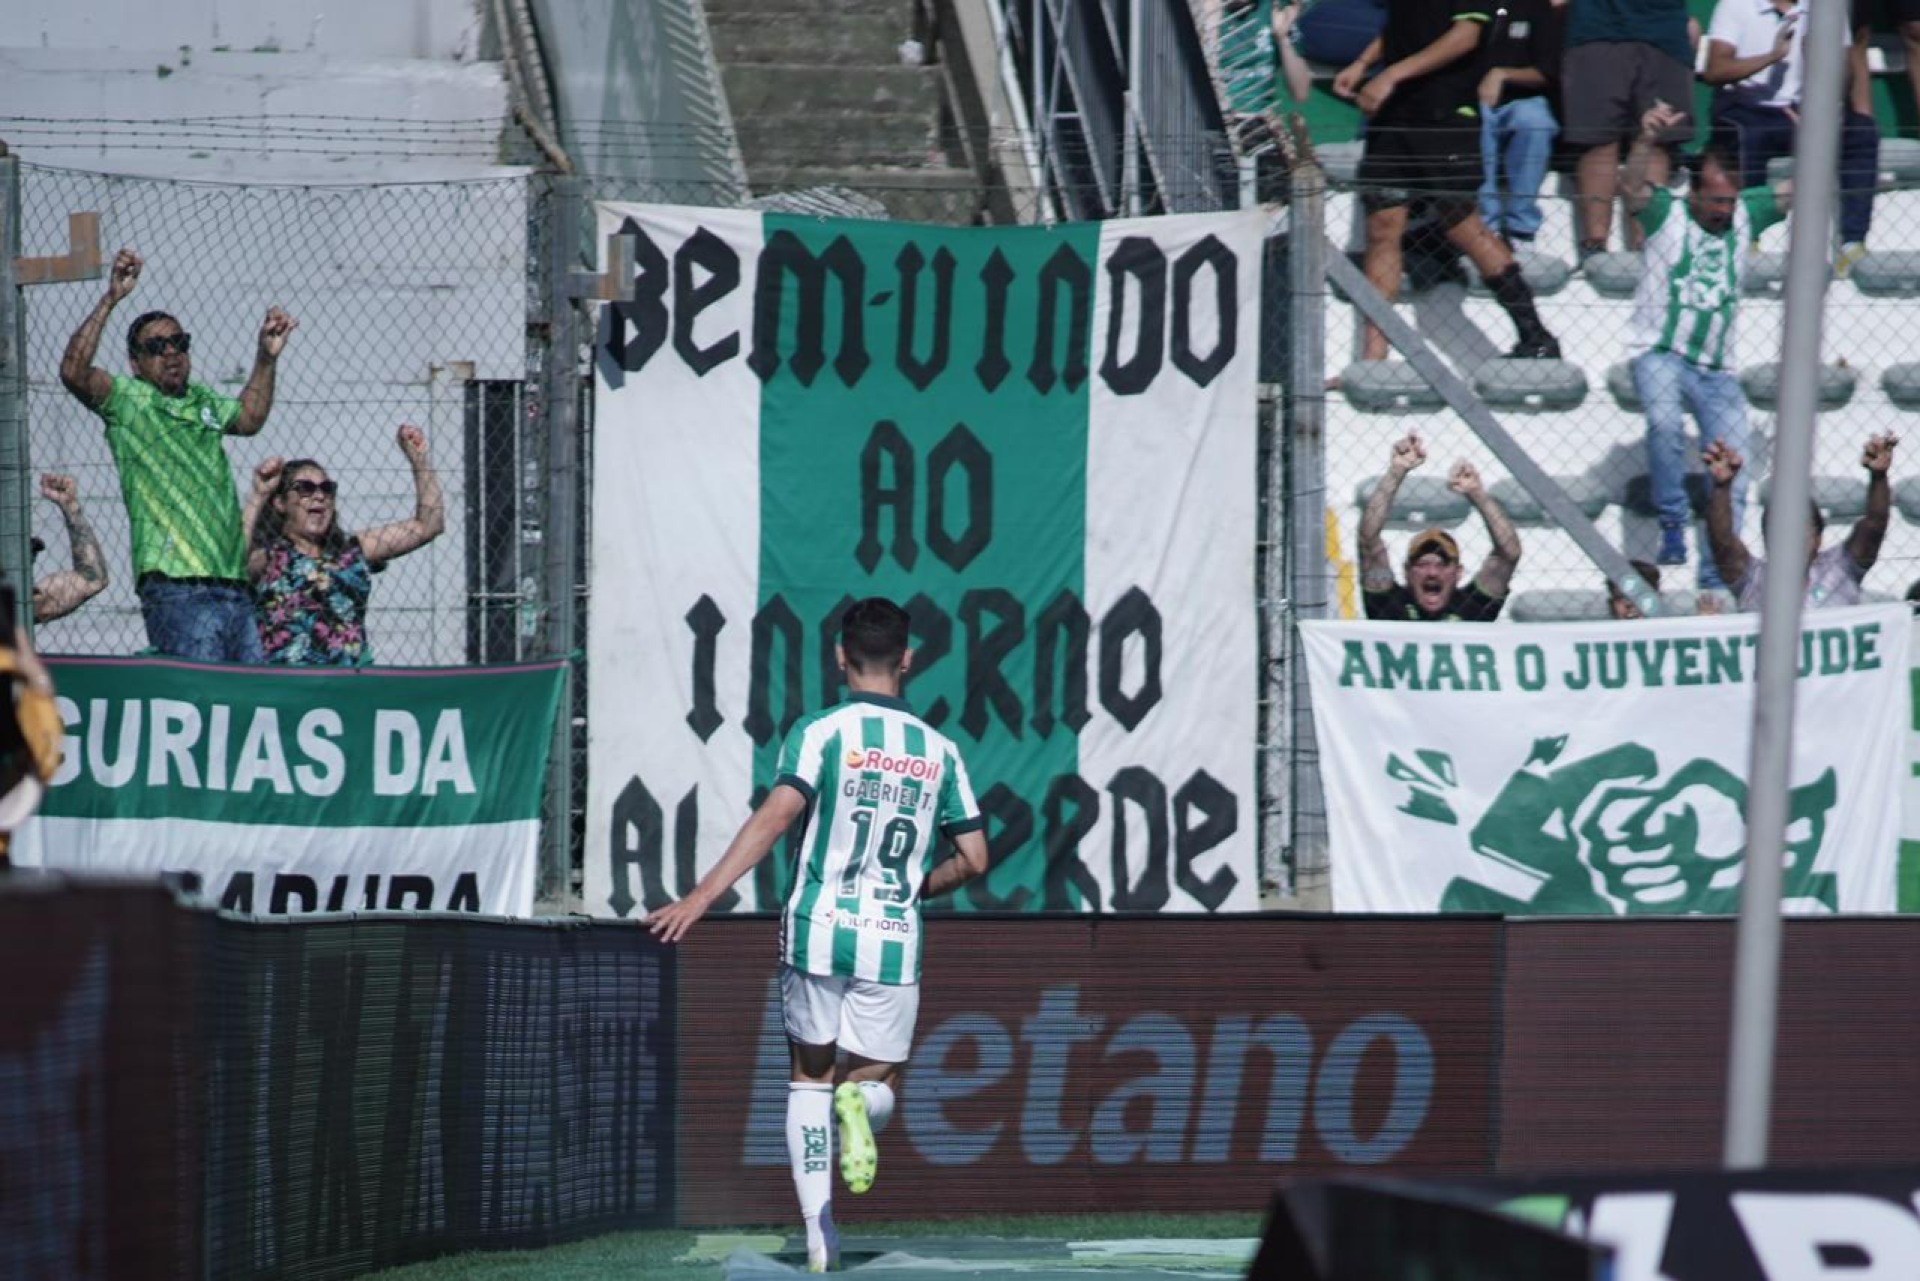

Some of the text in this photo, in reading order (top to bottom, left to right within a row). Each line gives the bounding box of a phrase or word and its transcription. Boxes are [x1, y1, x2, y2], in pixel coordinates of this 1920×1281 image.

[856, 420, 993, 574] AO
[1339, 640, 1501, 692] AMAR
[1515, 643, 1547, 692] O
[373, 708, 477, 797] DA
[865, 750, 941, 781] RodOil
[843, 778, 933, 812] GABRIEL T.
[839, 808, 919, 904] 19
